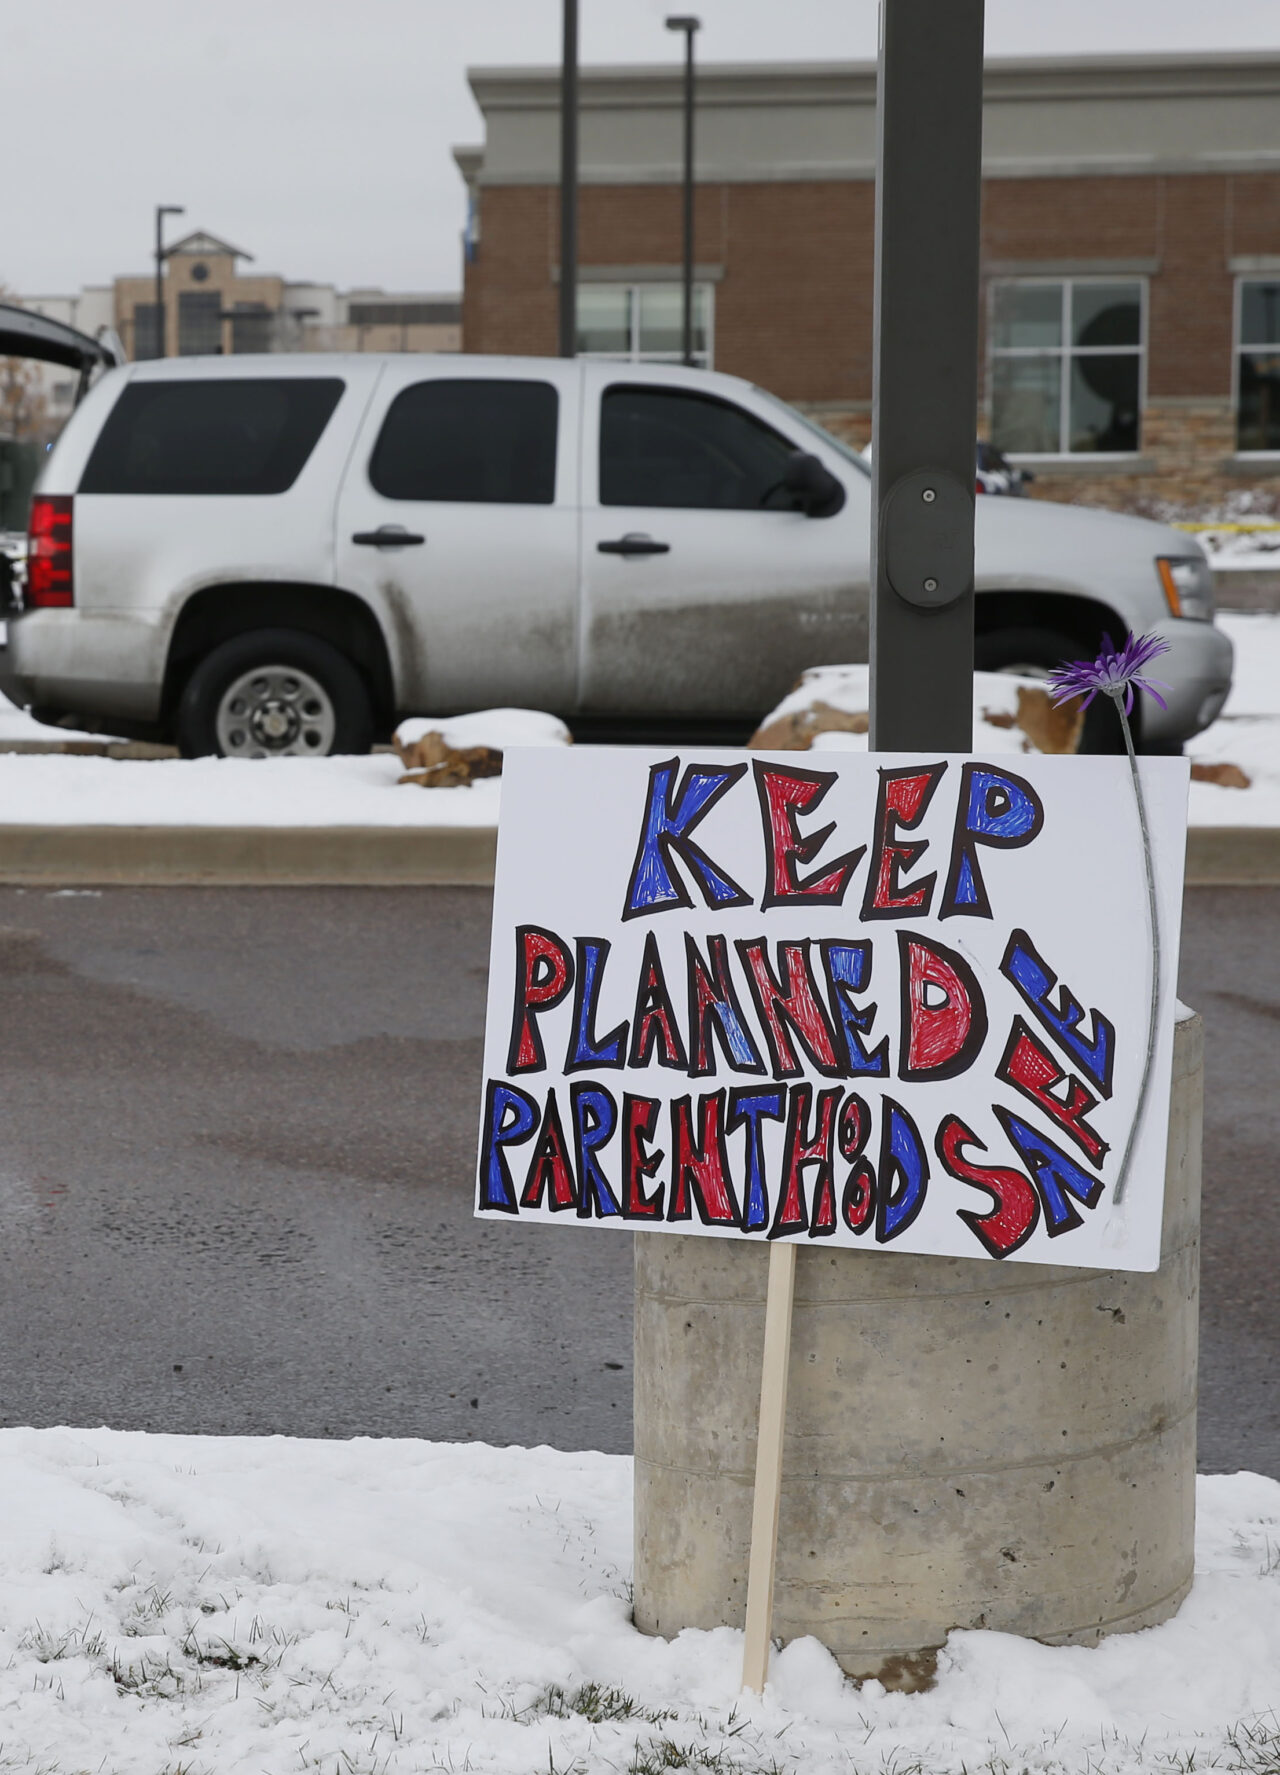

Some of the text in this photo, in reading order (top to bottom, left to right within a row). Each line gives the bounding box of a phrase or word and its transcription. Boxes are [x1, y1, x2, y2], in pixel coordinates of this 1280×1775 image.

[621, 757, 1044, 922] KEEP
[506, 925, 988, 1082] PLANNED
[479, 928, 1116, 1260] PARENTHOOD SAFE
